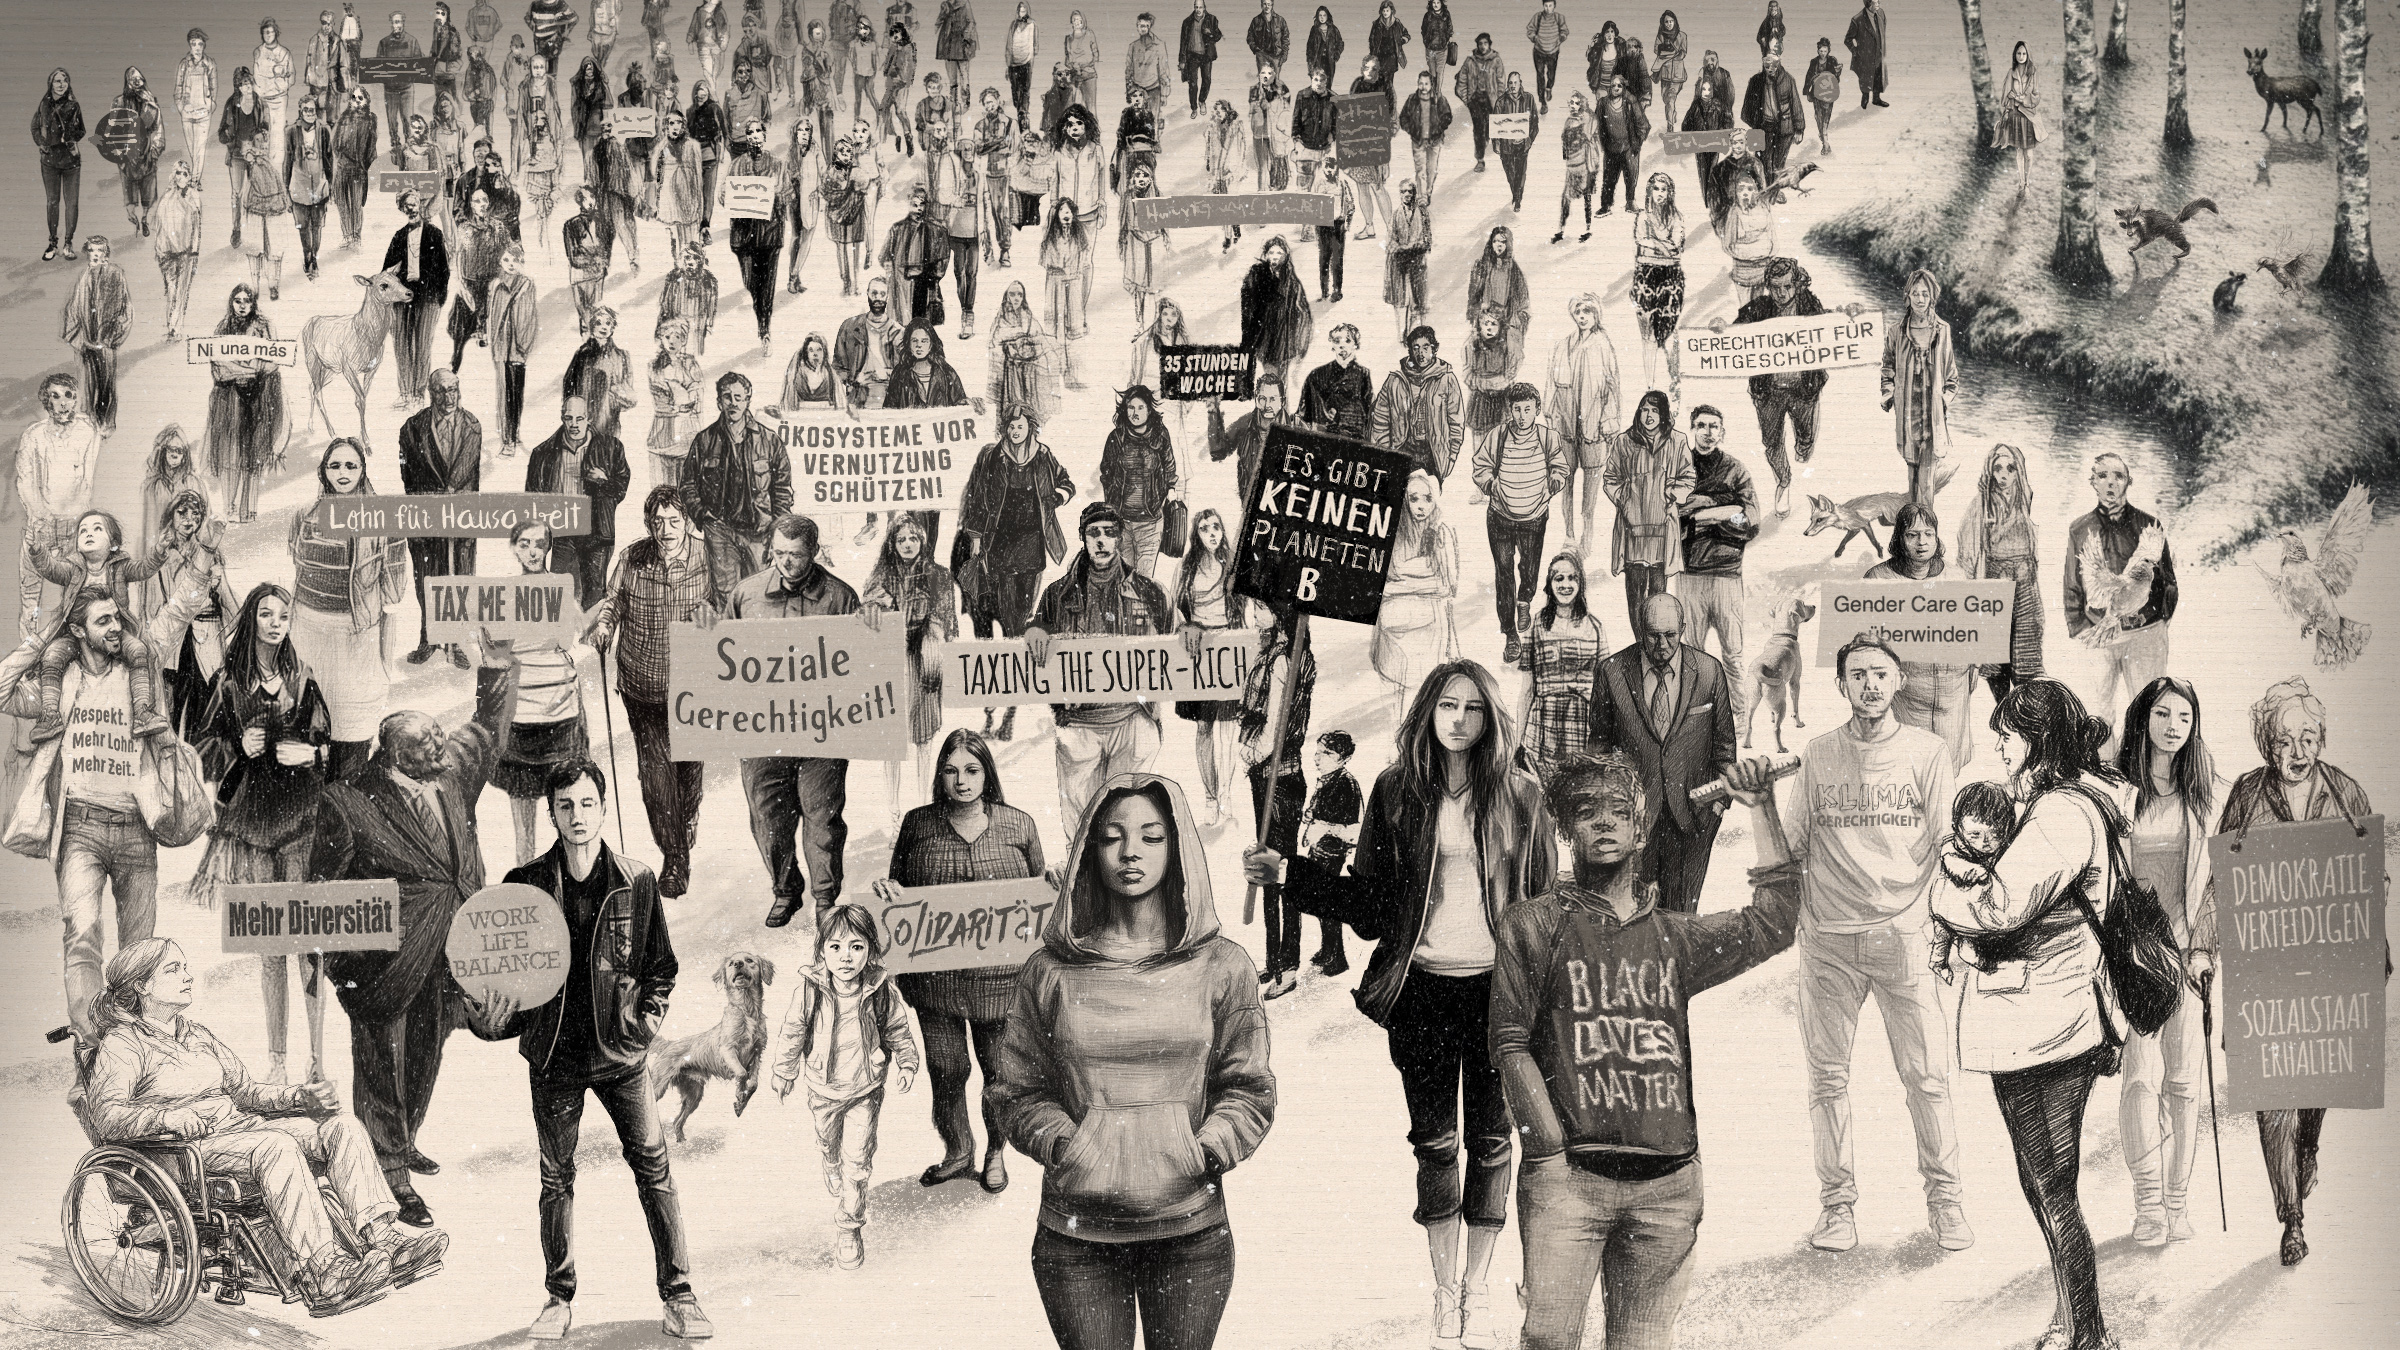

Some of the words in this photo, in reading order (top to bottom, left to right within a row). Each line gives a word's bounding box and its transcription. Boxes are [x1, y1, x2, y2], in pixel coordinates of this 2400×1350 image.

[197, 343, 213, 357] Ni
[220, 344, 250, 355] una
[253, 342, 287, 358] más
[1687, 327, 1825, 352] GERECHTIGKEIT
[1833, 320, 1874, 341] FÜR
[1164, 354, 1182, 373] 35
[1184, 353, 1250, 373] STUNDEN
[1700, 343, 1861, 370] MITGESCHÖPFE
[1180, 374, 1236, 394] WOCHE
[777, 420, 923, 448] ÖKOSYSTEME
[932, 418, 977, 444] VOR
[803, 448, 952, 476] VERNUTZUNG
[1283, 444, 1314, 478] ES
[1329, 458, 1387, 492] GIBT
[814, 476, 943, 502] SCHÜTZEN!
[329, 502, 385, 530] Lohn
[394, 503, 433, 530] für
[1259, 478, 1393, 539] KEINEN
[1251, 518, 1385, 574] PLANETEN
[1296, 566, 1320, 602] B
[431, 585, 469, 622] TAX
[478, 585, 506, 622] ME
[515, 585, 564, 623] NOW
[1833, 595, 1905, 613] Gender
[1911, 595, 1957, 613] Care
[1964, 595, 2004, 616] Gap
[717, 635, 850, 683] Soziale
[958, 651, 1050, 695] TAXING
[1056, 651, 1096, 693] THE
[72, 707, 128, 726] Respekt.
[675, 681, 896, 743] Gerechtigkeit!
[72, 730, 105, 749] Mehr
[107, 732, 138, 753] Lohn.
[72, 755, 106, 774] Mehr
[108, 757, 135, 777] Zeit.
[1816, 783, 1924, 811] KLIMA
[1816, 812, 1922, 828] GERECHTIGKEIT
[2232, 853, 2371, 906] DEMOKRATIE
[228, 900, 285, 937] Mehr
[288, 896, 393, 936] Diversität
[466, 905, 540, 930] WORK
[2234, 899, 2370, 951] VERTEIDIGEN
[480, 930, 529, 952] LIFE
[453, 951, 562, 978] BALANCE
[1566, 957, 1677, 1013] BLACK
[2241, 992, 2370, 1039] SOZIALSTAAT
[1574, 1014, 1683, 1068] LIVES
[2261, 1036, 2353, 1078] ERHALTEN
[1577, 1067, 1683, 1113] MATTER
